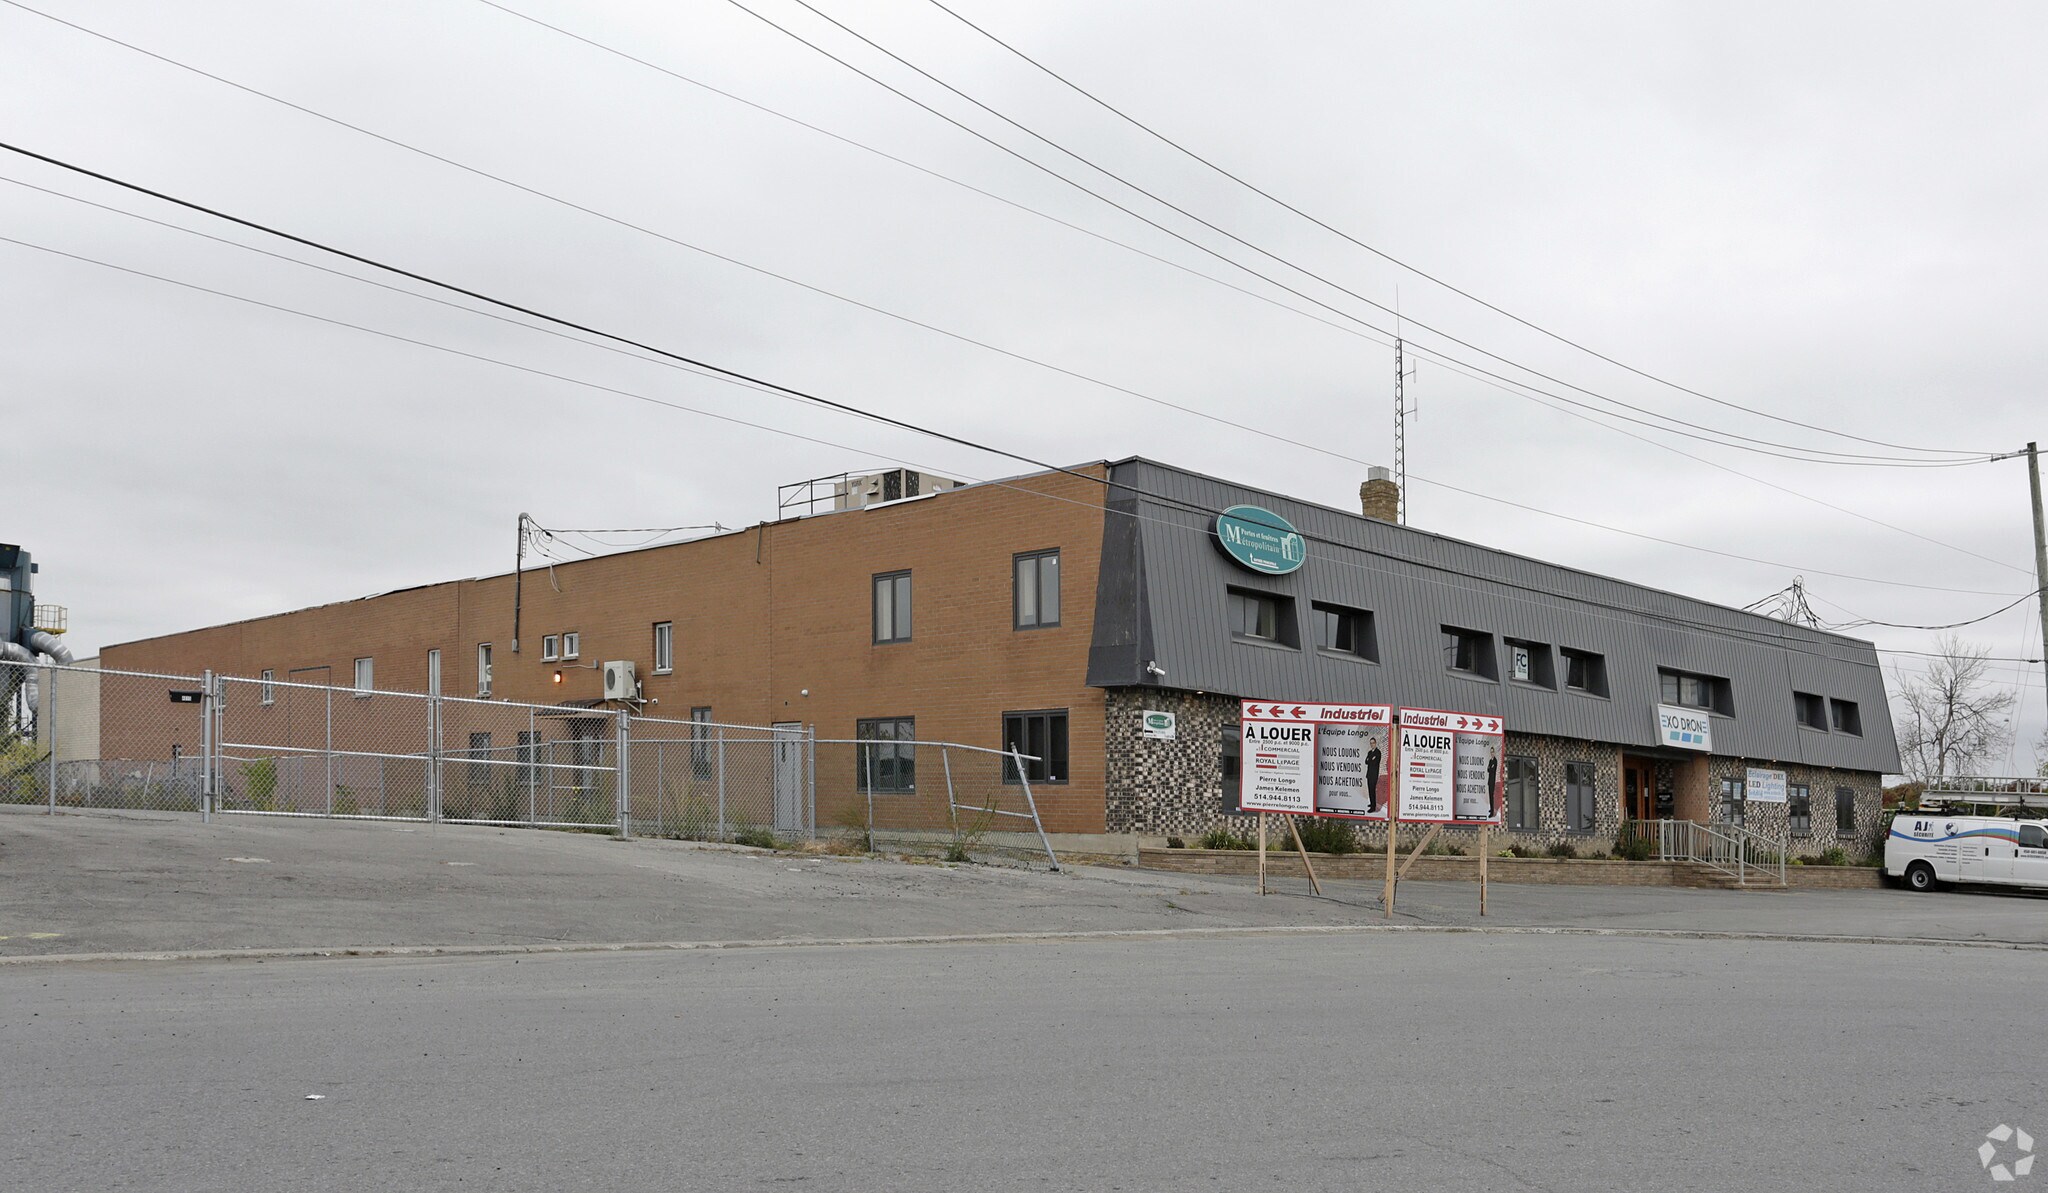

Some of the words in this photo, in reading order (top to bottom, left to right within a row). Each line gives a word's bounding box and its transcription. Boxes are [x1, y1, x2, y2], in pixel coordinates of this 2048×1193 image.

[1241, 528, 1255, 537] Portes
[1225, 523, 1280, 553] Métropolitain
[1516, 653, 1527, 668] FC
[1320, 708, 1384, 721] Industriel
[1403, 712, 1448, 727] Industriel
[1661, 714, 1680, 729] EXO
[1680, 717, 1708, 734] DRONE
[1245, 723, 1255, 739] À
[1260, 727, 1311, 742] LOUER
[1347, 729, 1369, 738] Longo
[1403, 730, 1410, 747] À
[1414, 734, 1451, 750] LOUER
[1476, 738, 1490, 747] Longo
[1322, 747, 1337, 757] NOUS
[1338, 748, 1360, 758] LOUONS
[1416, 754, 1442, 762] COMMERCIAL
[1459, 756, 1469, 765] NOUS
[1320, 761, 1335, 771] NOUS
[1336, 762, 1362, 773] VENDONS
[1457, 770, 1468, 780] NOUS
[1319, 775, 1333, 786] NOUS
[1335, 776, 1363, 787] ACHETONS
[1748, 780, 1761, 788] LED
[1275, 785, 1300, 793] Kelemen
[1456, 784, 1467, 794] NOUS
[1254, 793, 1301, 802] 514.944.8113
[1246, 801, 1309, 810] www.pierrelongo.com
